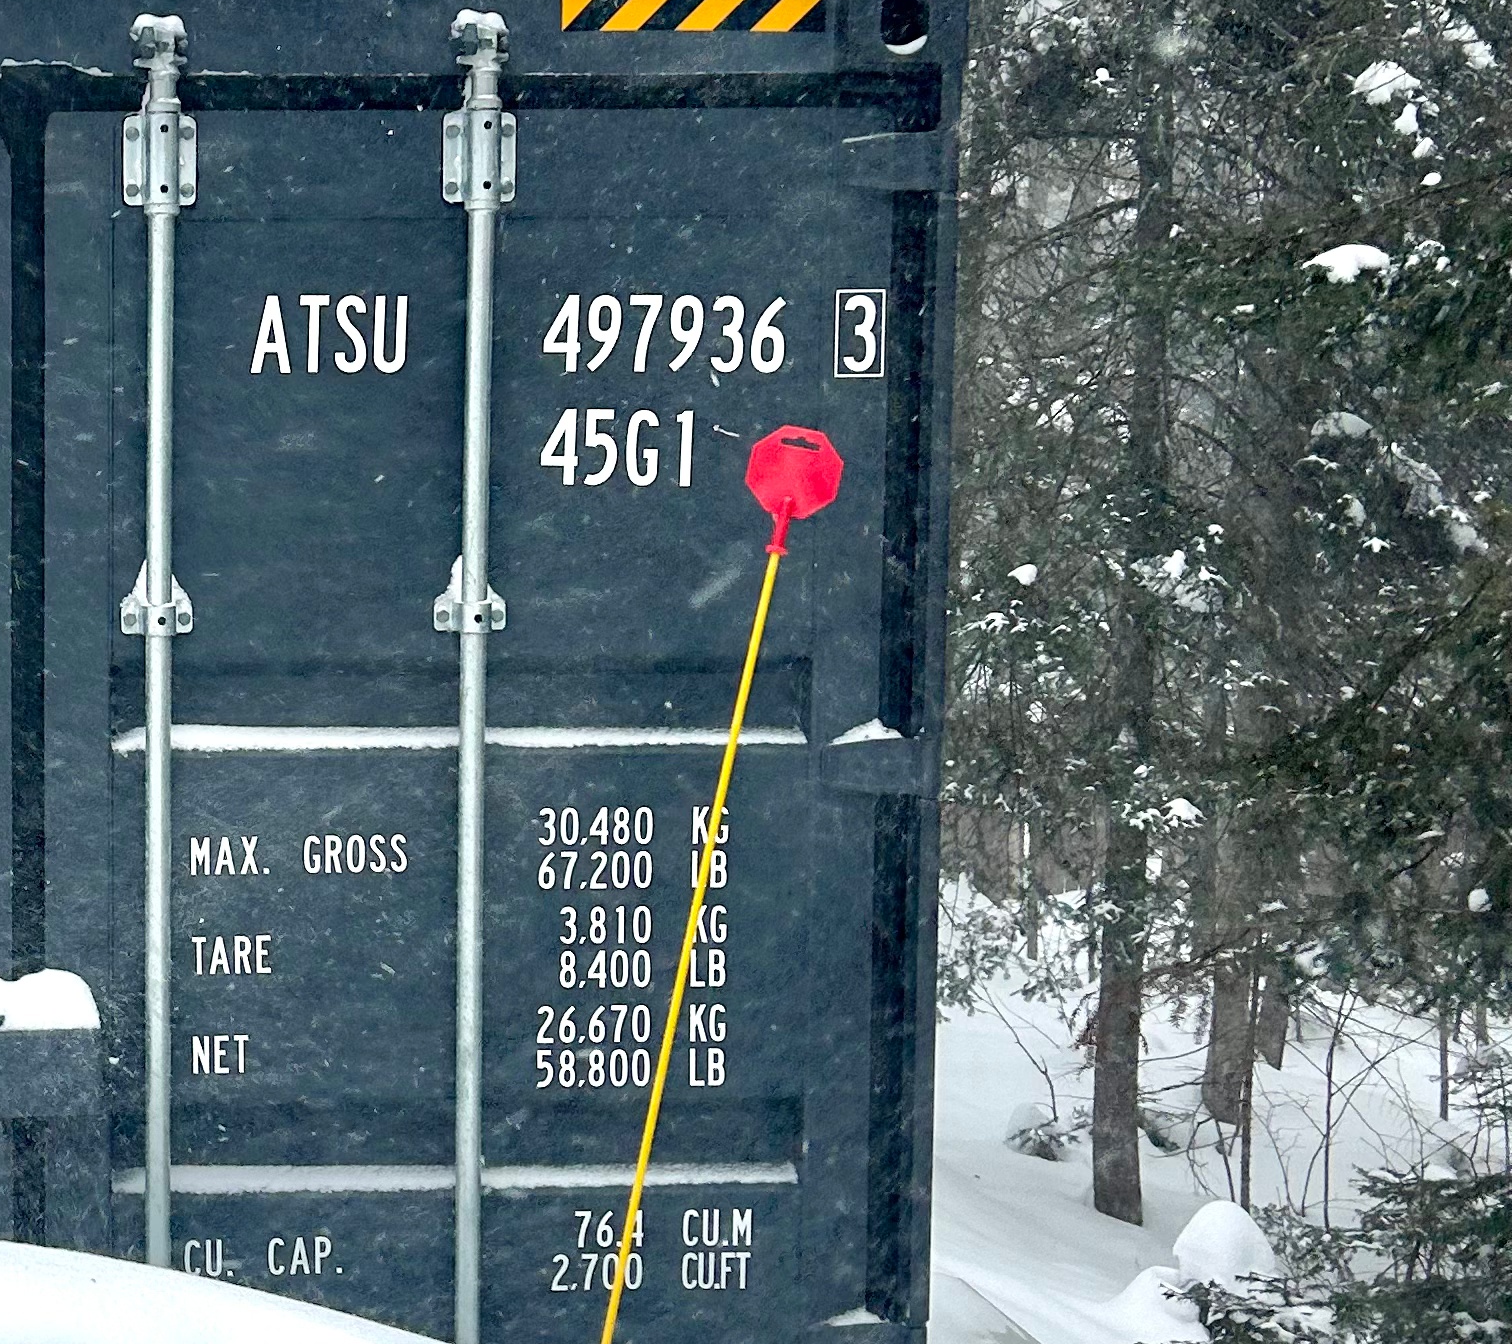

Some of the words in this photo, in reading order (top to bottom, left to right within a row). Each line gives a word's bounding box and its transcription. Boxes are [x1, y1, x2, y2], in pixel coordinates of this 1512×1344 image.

[249, 294, 409, 375] ATSU
[542, 293, 787, 374] 497936
[842, 294, 877, 372] 3
[539, 408, 695, 487] 45G1
[537, 806, 654, 846] 30,480
[691, 806, 730, 844] KG
[189, 835, 271, 876] MAX.
[302, 833, 409, 874] GROSS
[537, 850, 653, 890] 67,200
[691, 850, 728, 889] LB
[558, 905, 652, 946] 3,810
[691, 905, 728, 944] KG
[191, 934, 273, 975] TARE
[558, 949, 652, 990] 8,400
[689, 949, 727, 988] LB
[535, 1004, 651, 1045] 26,670
[688, 1003, 727, 1043] KG
[191, 1034, 250, 1075] NET
[535, 1049, 651, 1090] 58,800
[688, 1048, 726, 1088] LB
[681, 1209, 753, 1247] CU.M
[183, 1239, 235, 1278] CU.
[267, 1236, 344, 1276] CAP.
[550, 1252, 644, 1291] 2,700
[681, 1251, 752, 1290] CU.FT
